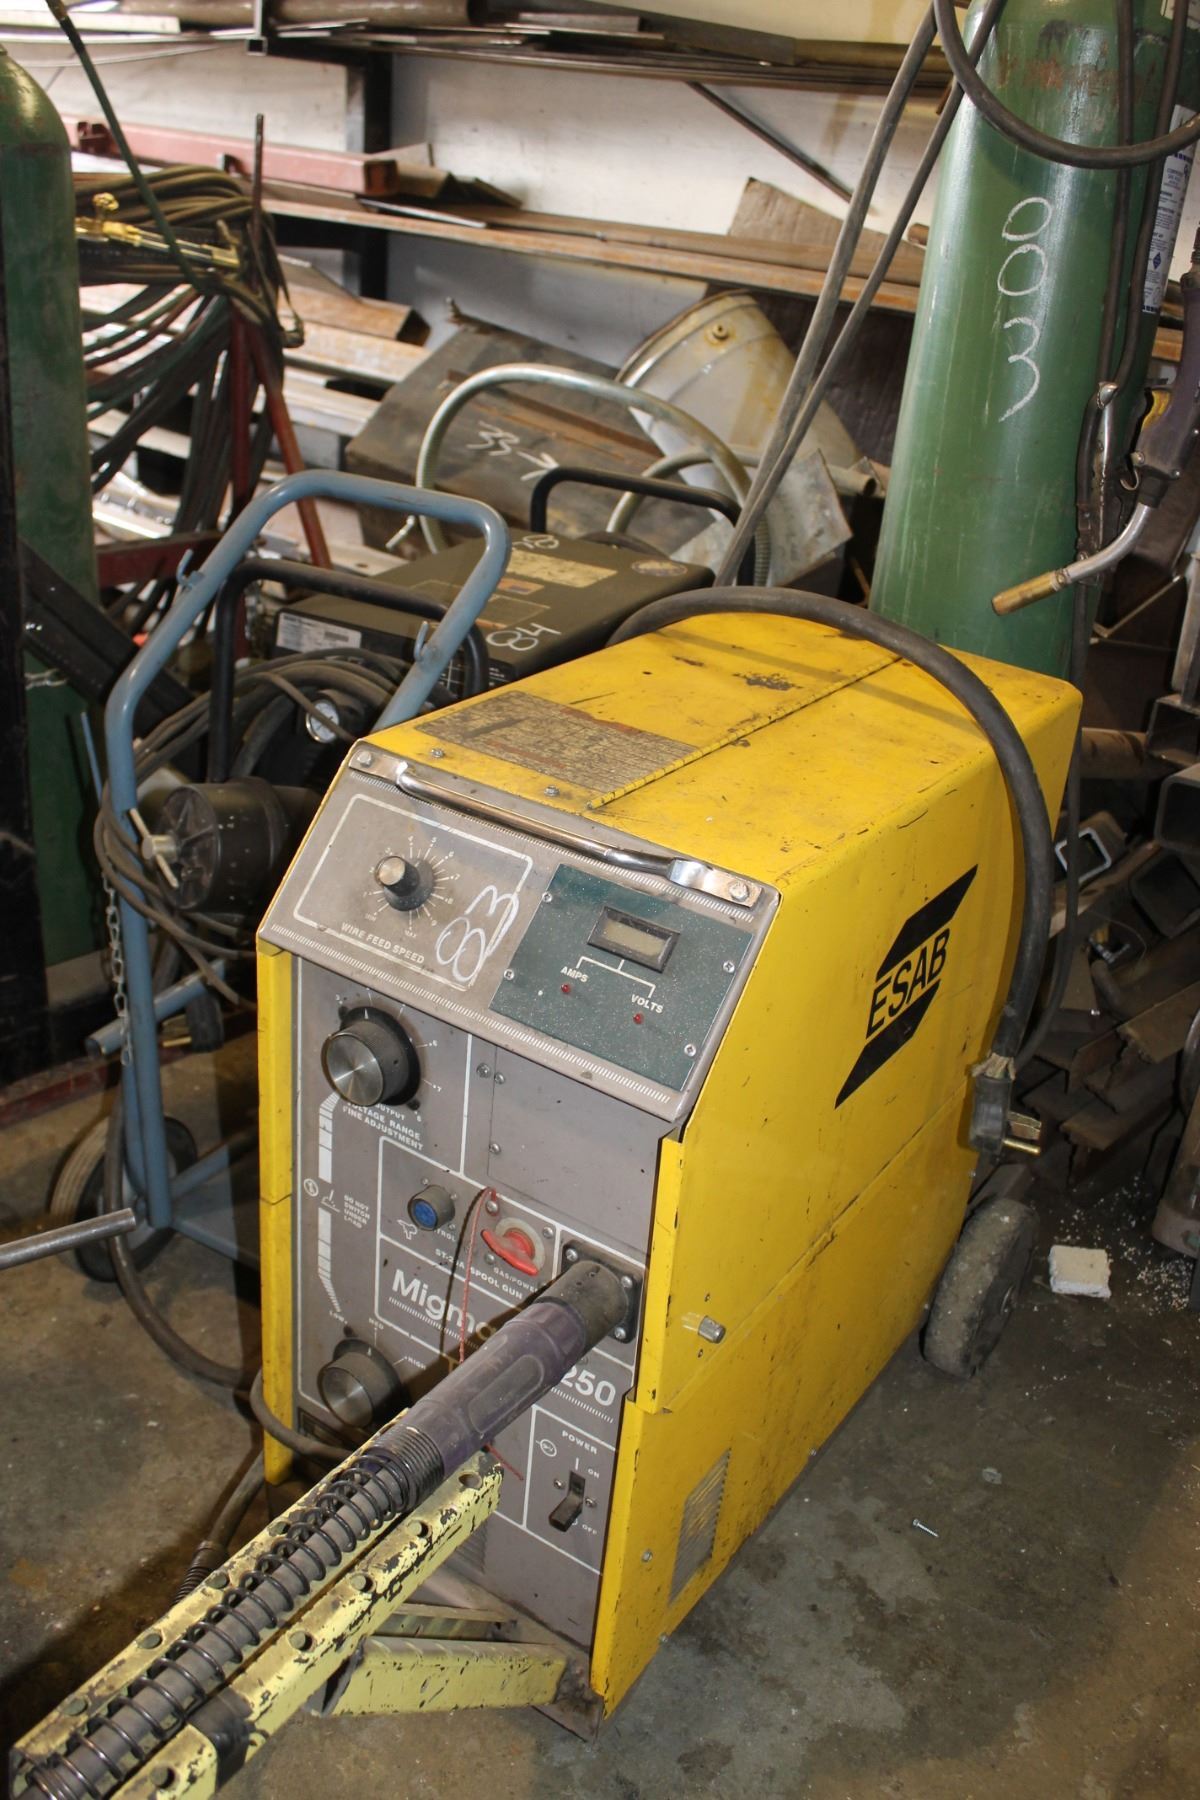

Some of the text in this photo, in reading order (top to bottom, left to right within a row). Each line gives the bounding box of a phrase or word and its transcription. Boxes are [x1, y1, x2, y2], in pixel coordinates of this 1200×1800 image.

[341, 922, 425, 964] WIRE FEED SPEED
[561, 966, 588, 982] AMPS
[866, 928, 950, 1040] ESAB
[631, 994, 664, 1013] VOLTS
[364, 1116, 424, 1151] ADJUSTMENT
[389, 1119, 421, 1141] RANGE
[344, 1201, 370, 1220] SWITCH
[469, 1266, 500, 1288] SPOOL
[502, 1283, 523, 1299] GUN
[560, 1365, 617, 1407] 250
[561, 1430, 598, 1454] POWER
[587, 1468, 600, 1478] ON
[582, 1524, 598, 1535] OFF
